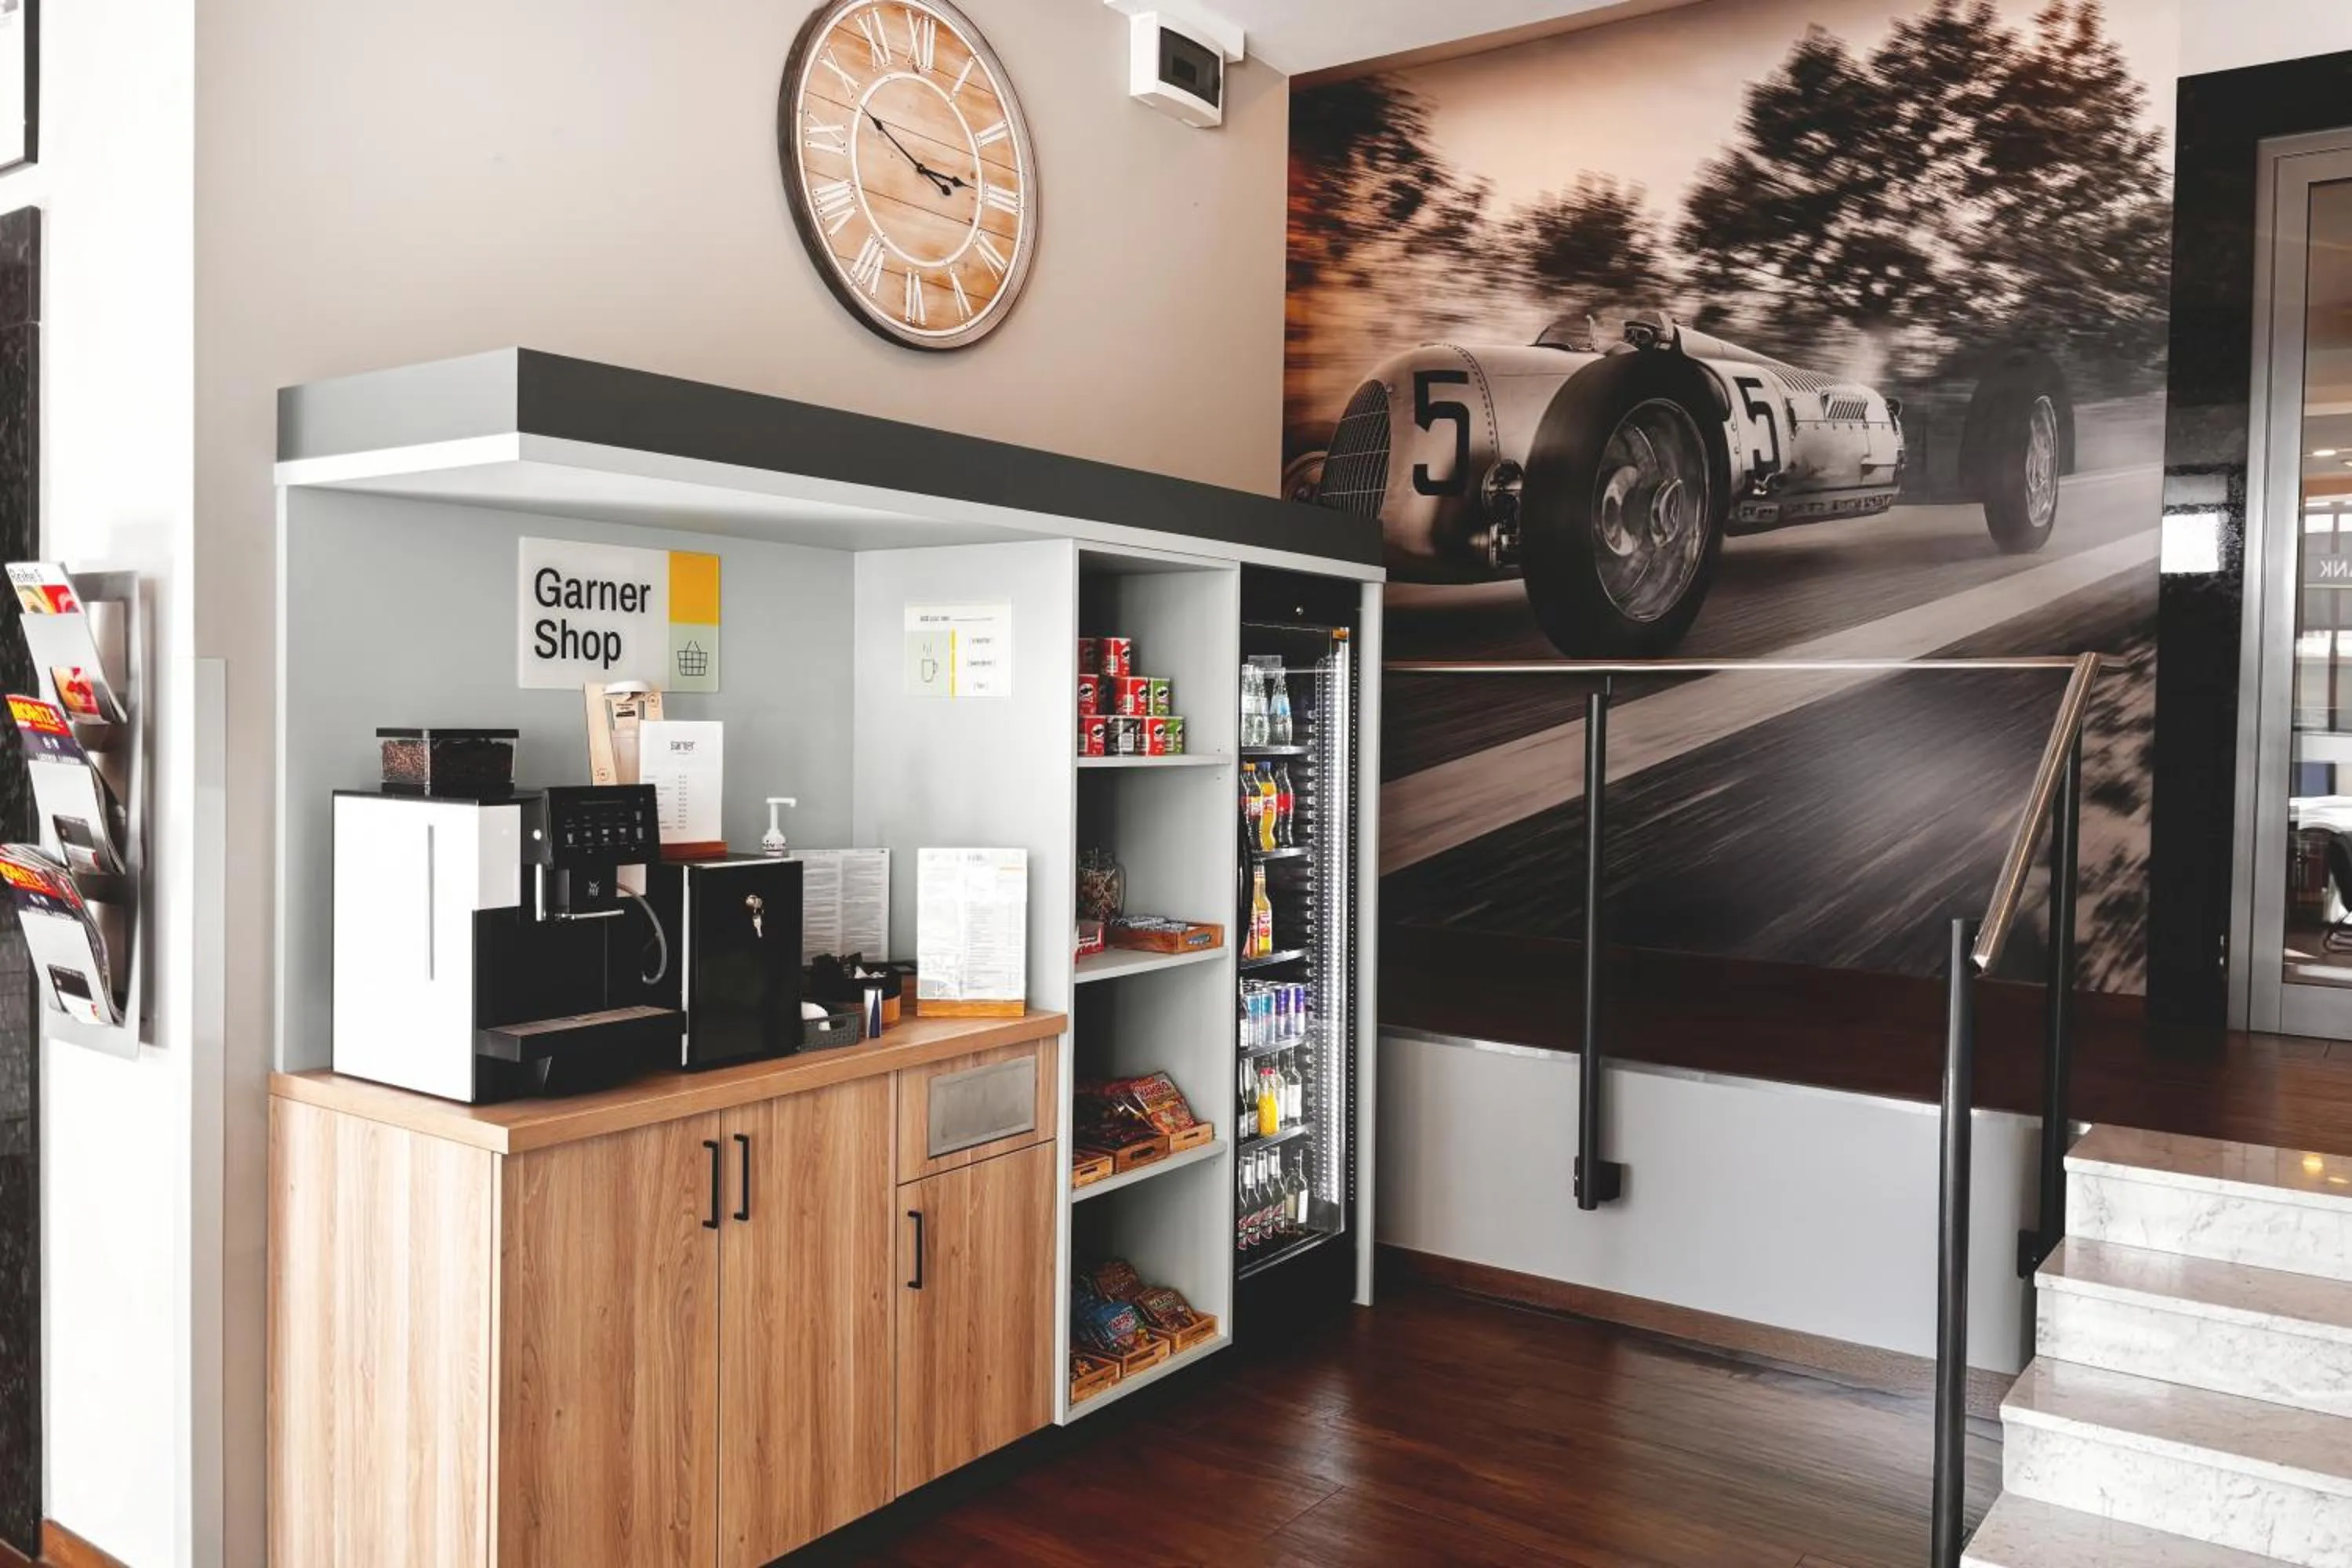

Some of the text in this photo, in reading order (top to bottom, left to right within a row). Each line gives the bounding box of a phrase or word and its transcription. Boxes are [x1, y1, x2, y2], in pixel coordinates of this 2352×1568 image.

[1412, 369, 1470, 496] 5
[1733, 376, 1783, 476] 5
[534, 568, 652, 613] Garner
[534, 619, 622, 670] Shop
